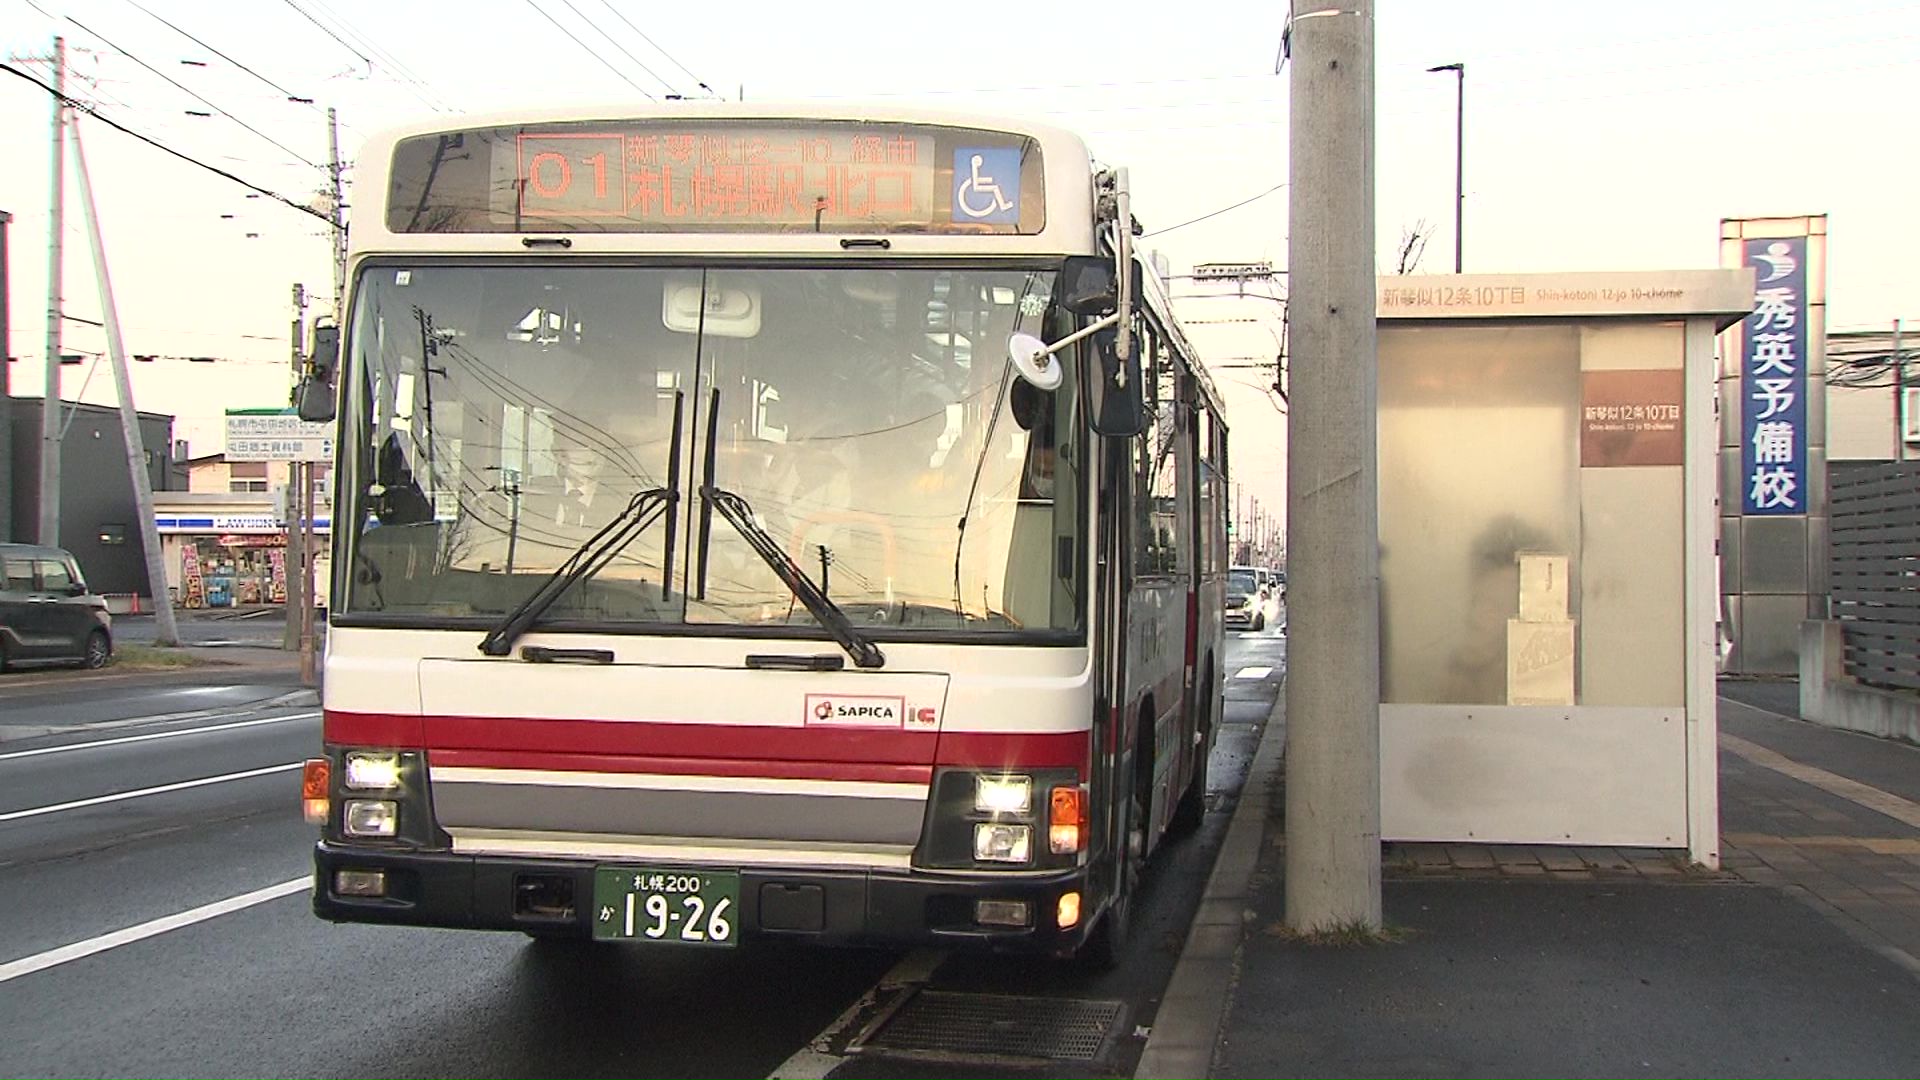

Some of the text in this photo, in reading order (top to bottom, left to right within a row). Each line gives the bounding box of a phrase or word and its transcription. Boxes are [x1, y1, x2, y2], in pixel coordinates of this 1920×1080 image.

[851, 135, 916, 164] 経由
[528, 152, 608, 198] 01
[628, 163, 913, 217] 札幌駅北口
[1383, 287, 1525, 306] 新琴似12条10丁目
[1536, 288, 1598, 300] Shin-kotoni
[1631, 287, 1684, 299] 10-chome
[1585, 405, 1680, 420] 新琴似12条10丁目
[1751, 288, 1796, 509] 秀英予備校
[837, 706, 893, 719] SAPICA
[600, 893, 731, 941] か 19-26
